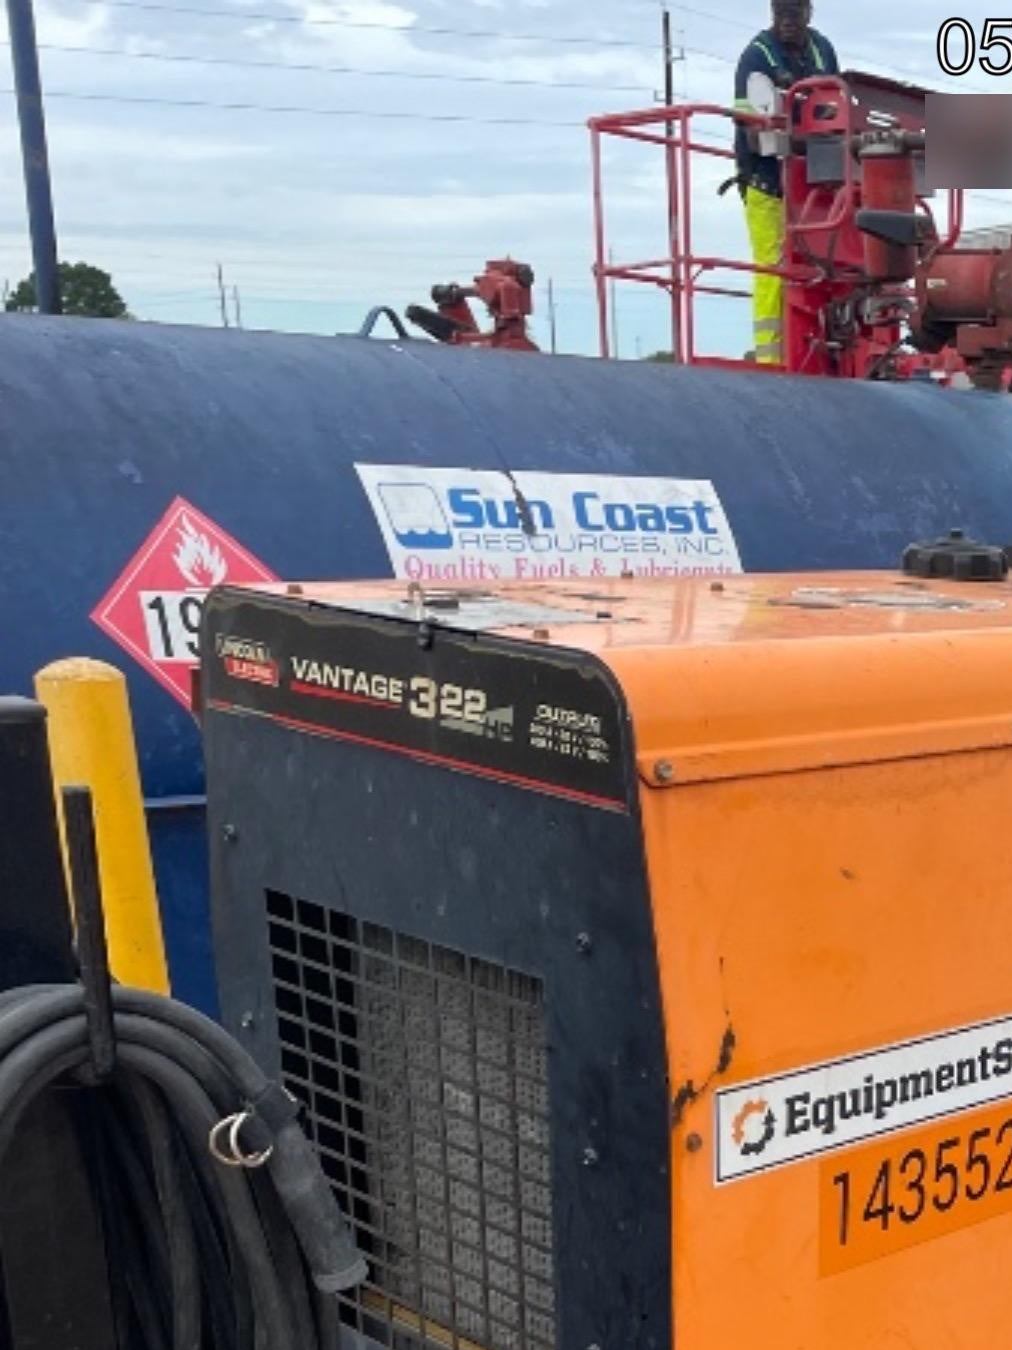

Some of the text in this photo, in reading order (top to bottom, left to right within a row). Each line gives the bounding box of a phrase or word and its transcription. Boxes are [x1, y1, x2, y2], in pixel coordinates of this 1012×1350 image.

[448, 487, 718, 535] Sun Coast
[676, 536, 730, 558] INC.
[514, 557, 579, 578] Fuels
[290, 655, 487, 724] VANTAGE 322
